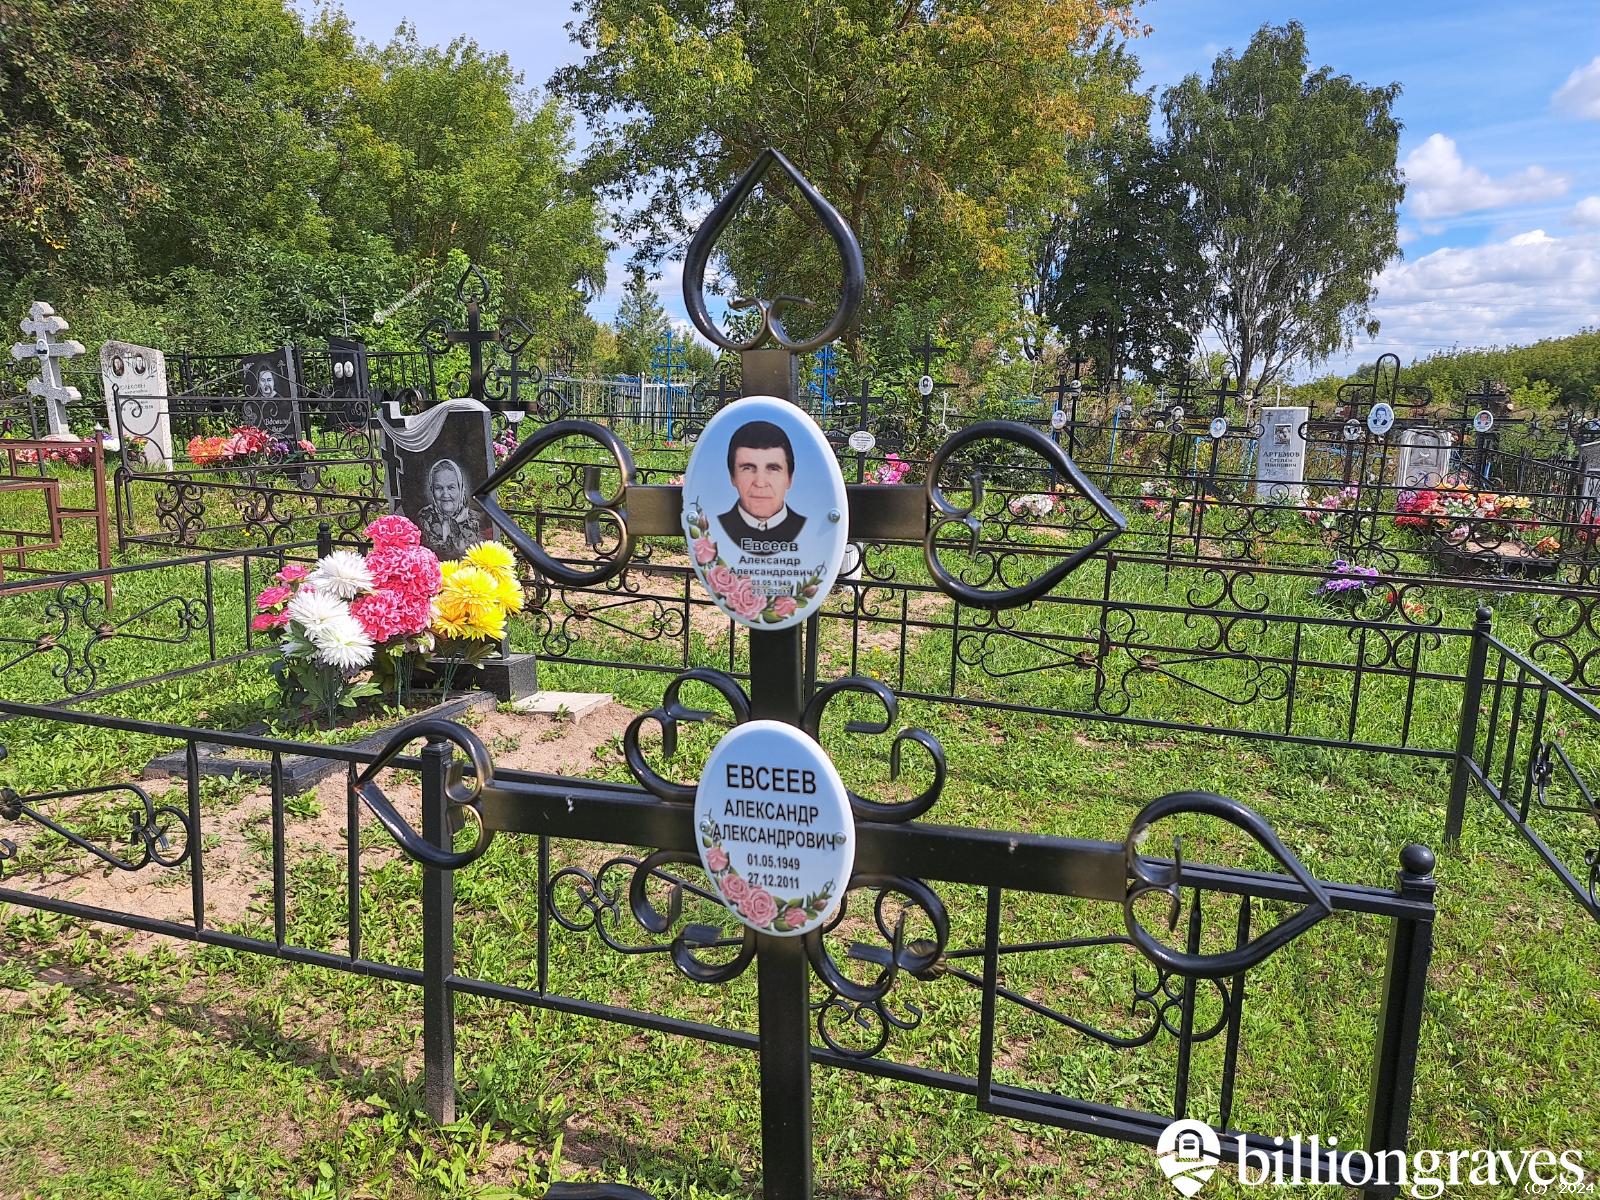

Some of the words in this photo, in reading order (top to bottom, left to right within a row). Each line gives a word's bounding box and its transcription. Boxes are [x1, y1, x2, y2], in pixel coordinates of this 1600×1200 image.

[741, 537, 799, 552] Евсеев
[739, 555, 801, 567] Александр
[728, 566, 813, 577] Александрович
[726, 763, 817, 794] ЕВСЕЕВ
[724, 799, 819, 826] АЛЕКСАНДР
[713, 824, 836, 851] АЛЕКСАНДРОВИЧ
[747, 853, 800, 870] 01.05.1949
[747, 872, 800, 889] 27.12.2011
